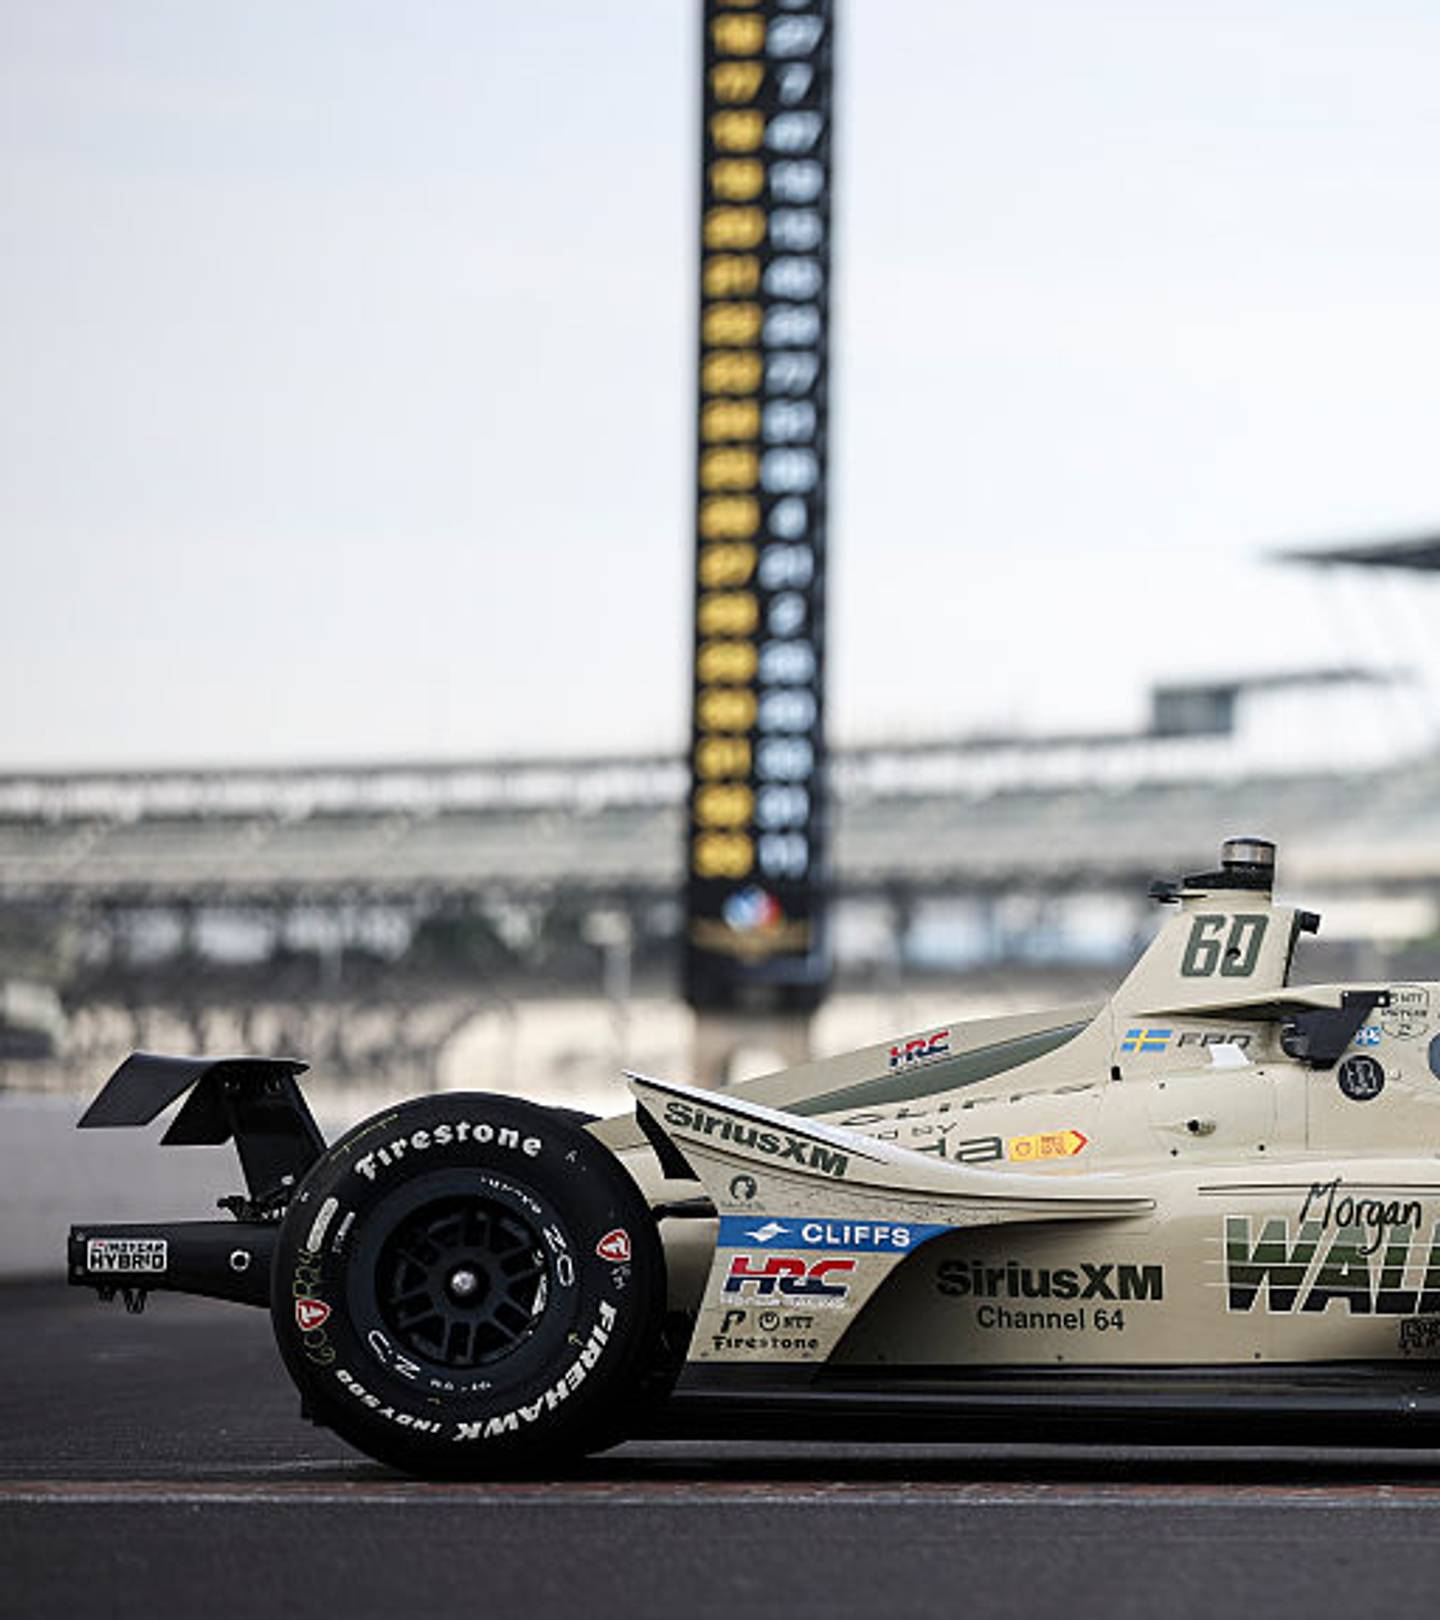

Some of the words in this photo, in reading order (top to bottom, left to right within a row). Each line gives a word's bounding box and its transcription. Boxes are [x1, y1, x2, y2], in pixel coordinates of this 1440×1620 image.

[1180, 913, 1269, 978] 60
[354, 1121, 543, 1181] Firestone
[664, 1101, 849, 1177] SiriusXM
[801, 1223, 911, 1248] CLIFFS
[1300, 1177, 1423, 1256] Morgan
[90, 1253, 165, 1270] HYBRID
[723, 1256, 858, 1298] HRC
[937, 1261, 1164, 1301] SiriusXM
[977, 1305, 1086, 1332] Channel
[1093, 1309, 1124, 1332] 64
[712, 1335, 820, 1351] Firestone
[452, 1300, 618, 1442] FIREHAWK
